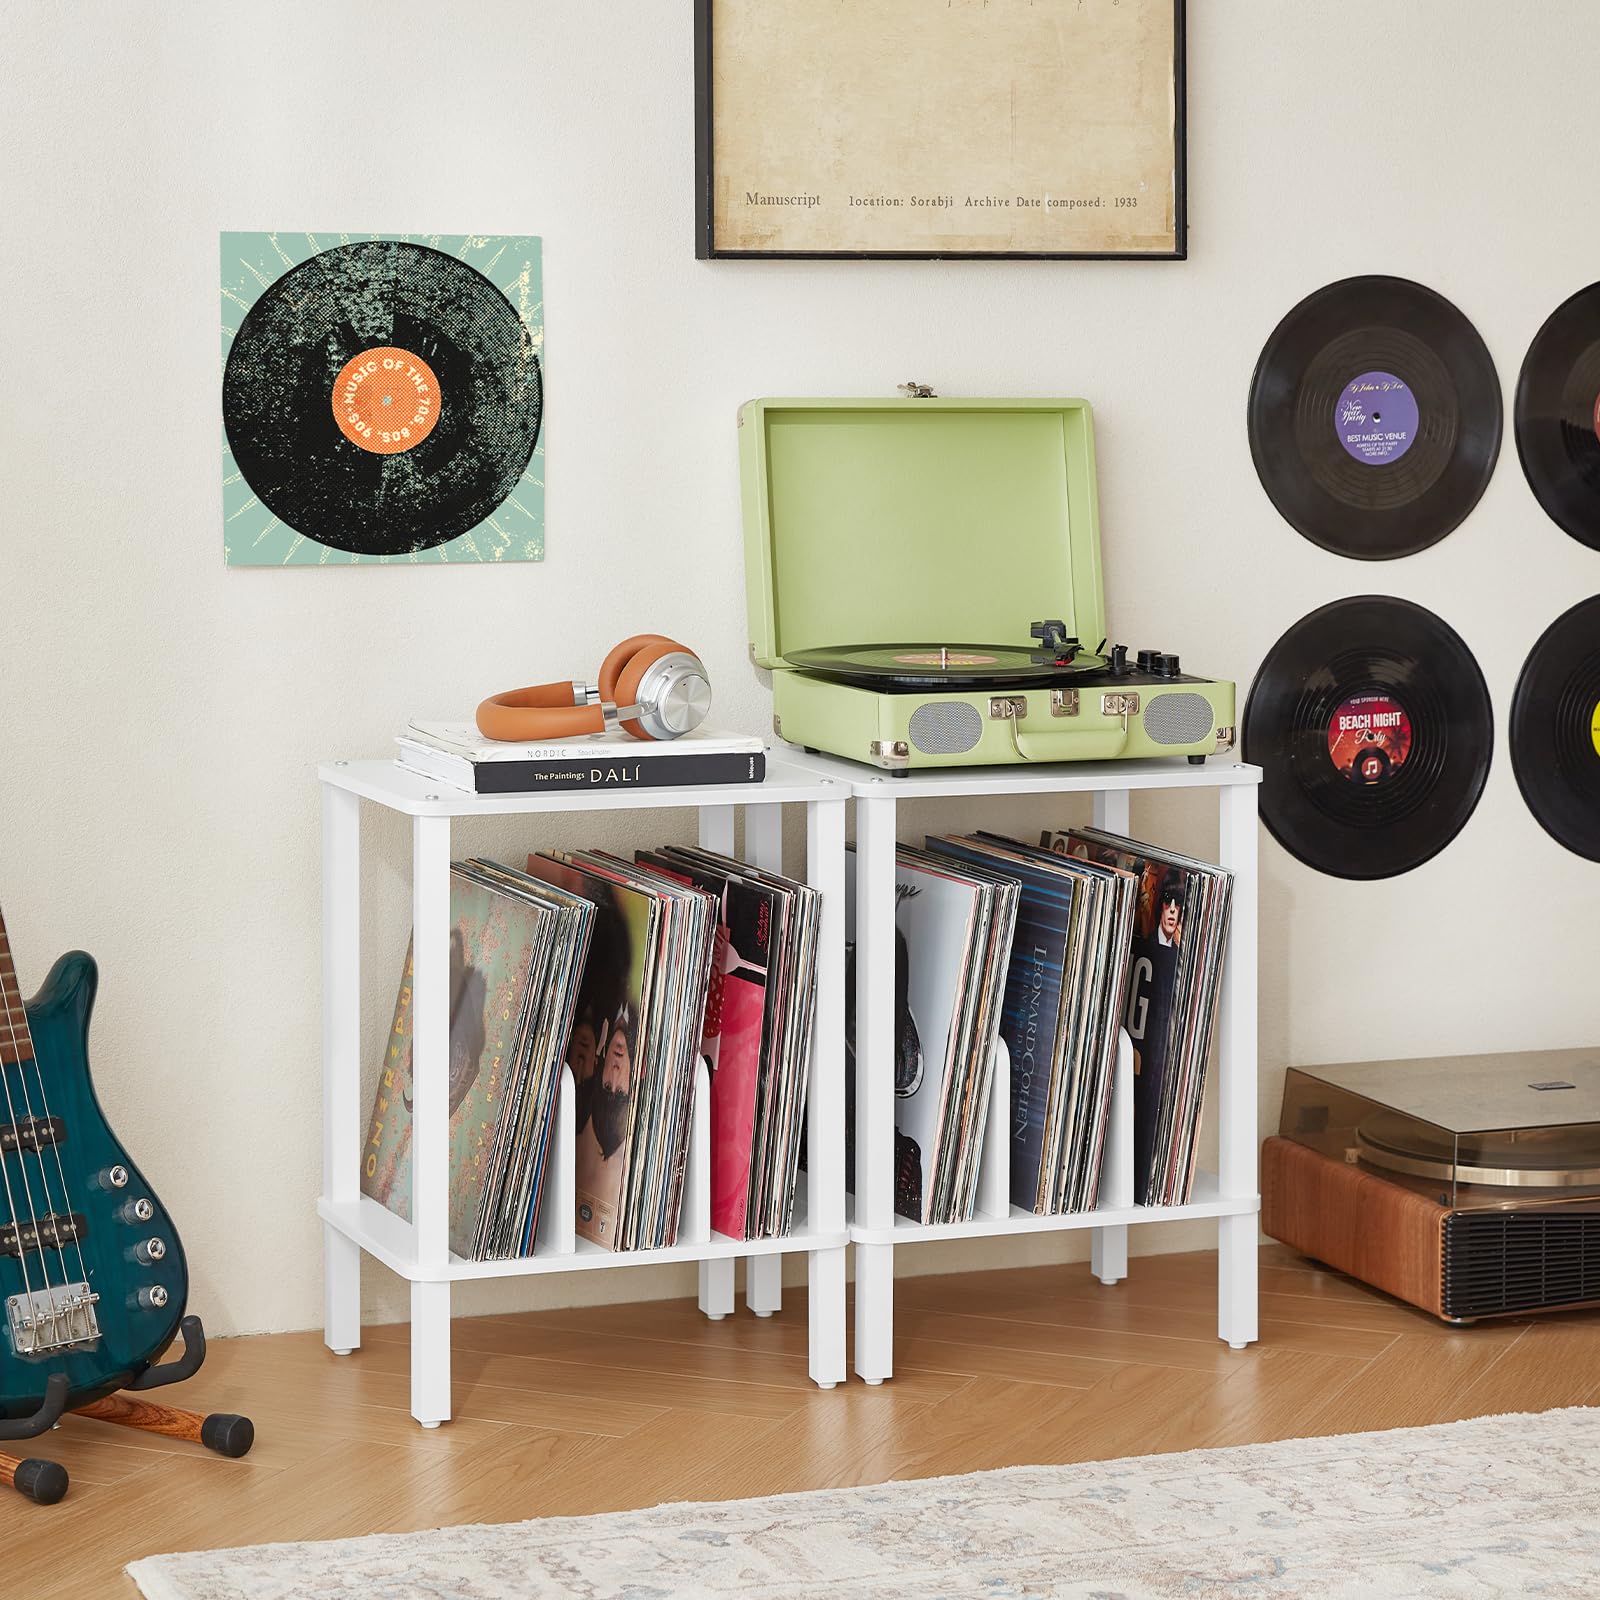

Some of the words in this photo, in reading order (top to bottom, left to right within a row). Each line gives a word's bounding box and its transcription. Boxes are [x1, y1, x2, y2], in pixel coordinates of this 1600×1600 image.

[745, 192, 821, 208] Manuscript
[849, 195, 904, 207] location:
[910, 195, 953, 208] Sorabji
[964, 196, 1010, 207] Archive
[1016, 196, 1041, 207] Date
[1047, 196, 1106, 209] composed:
[1114, 197, 1138, 208] 1933
[343, 361, 378, 404] MUSIC
[382, 358, 405, 371] OF
[406, 366, 429, 393] THE
[1347, 434, 1361, 443] BEST
[1362, 433, 1384, 441] MUSIC
[1384, 432, 1407, 440] VENUE
[1339, 714, 1371, 730] BEACH
[1373, 711, 1402, 728] NIGHT
[1354, 728, 1386, 747] Prty
[527, 749, 567, 758] NORDIC
[534, 773, 549, 781] The
[549, 771, 585, 781] Paintings
[590, 764, 641, 783] DALÍ
[471, 1122, 487, 1182] LOVE
[486, 1041, 503, 1103] RUNS
[503, 976, 517, 1021] OUT
